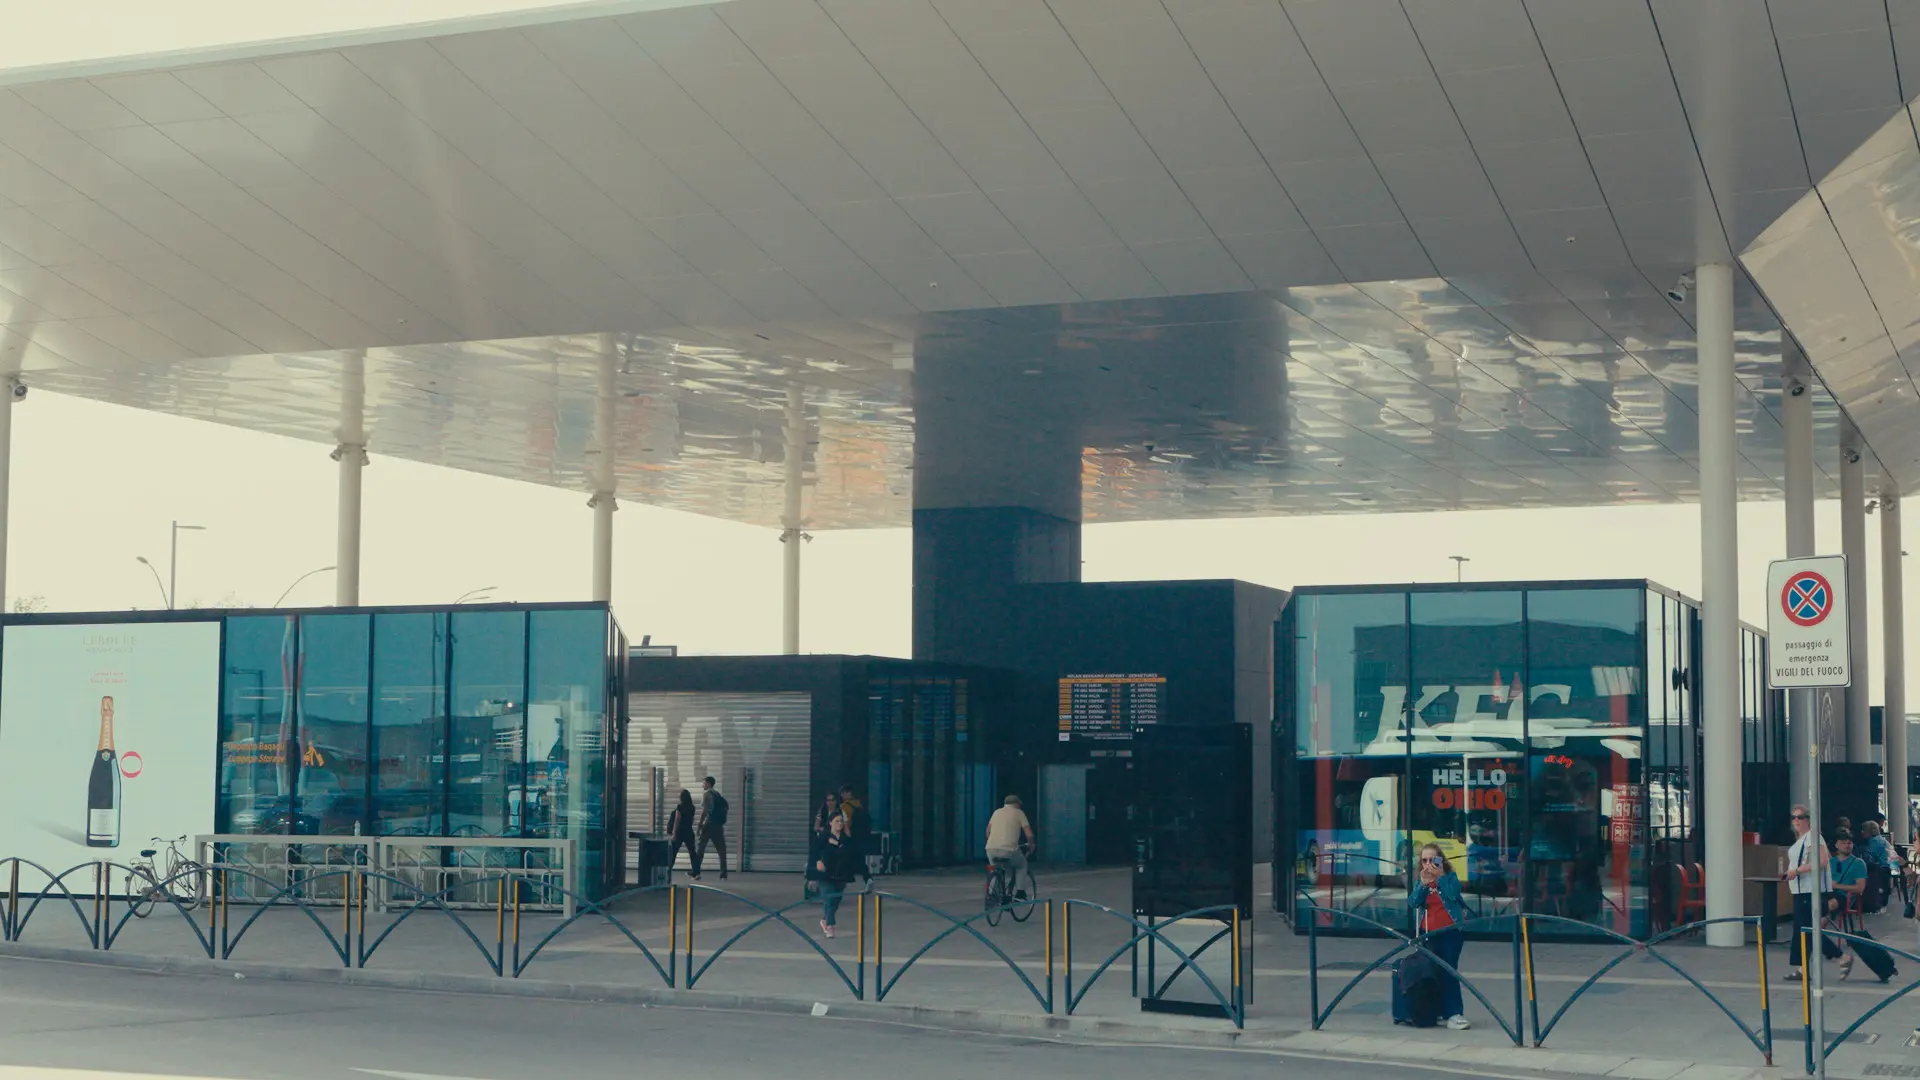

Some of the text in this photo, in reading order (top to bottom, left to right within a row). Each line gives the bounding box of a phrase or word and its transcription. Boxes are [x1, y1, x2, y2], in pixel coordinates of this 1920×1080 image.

[1785, 638, 1832, 650] passaggio di
[1788, 655, 1829, 664] emergenza
[1775, 666, 1843, 677] VIGILI DEL FUOCO
[1370, 684, 1572, 748] KFC
[1432, 768, 1507, 786] HELLO
[1431, 788, 1507, 810] ORIO
